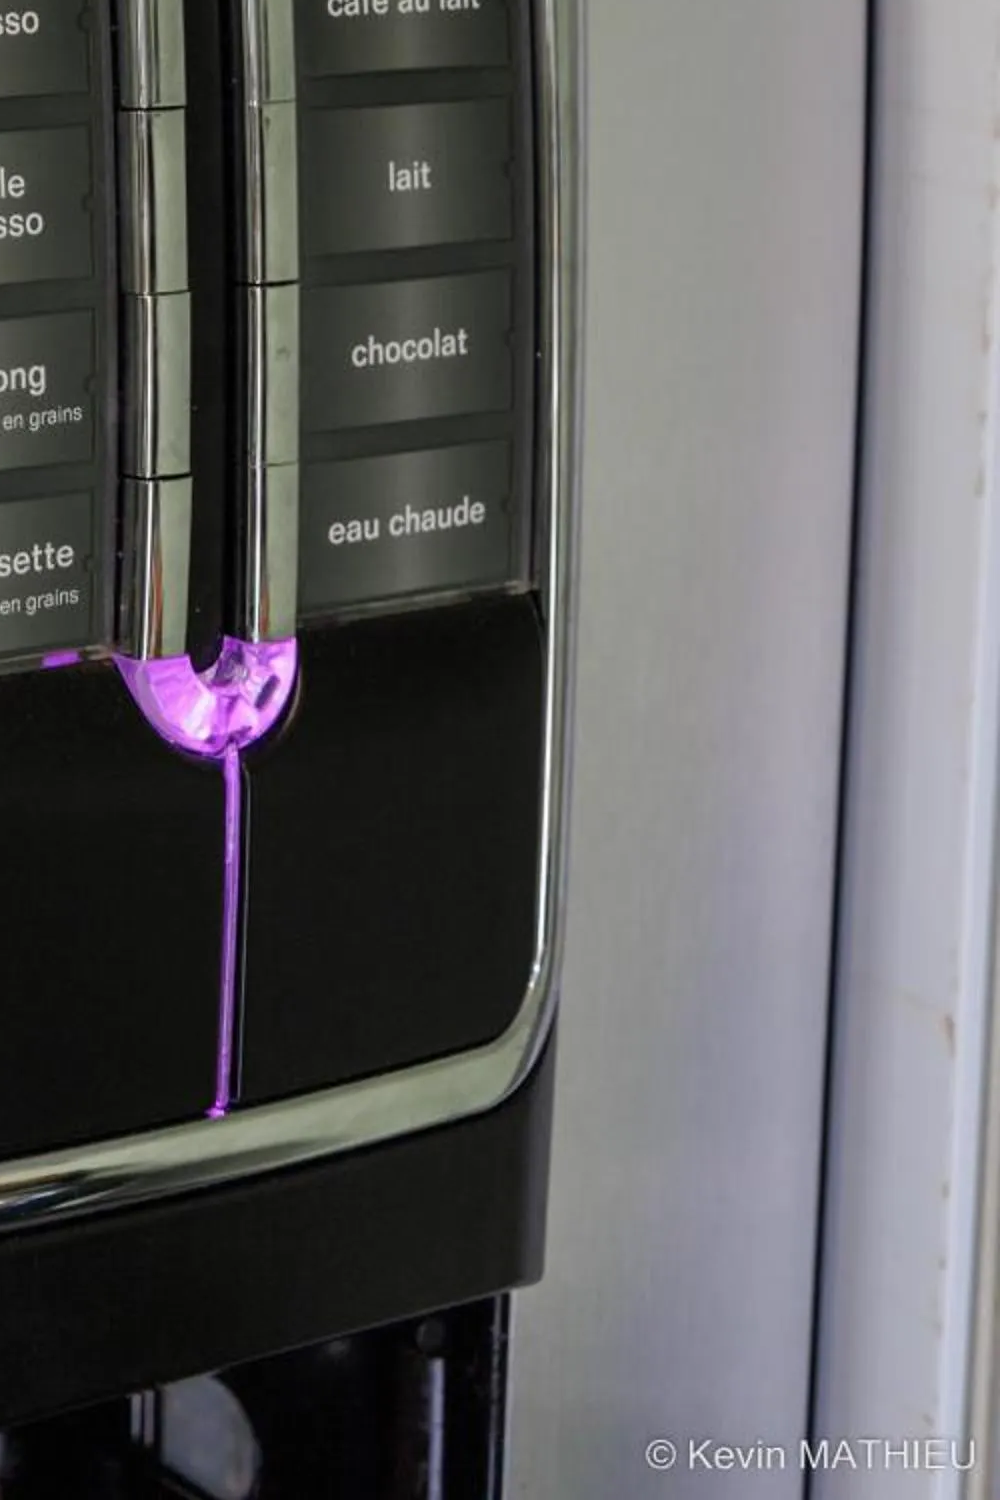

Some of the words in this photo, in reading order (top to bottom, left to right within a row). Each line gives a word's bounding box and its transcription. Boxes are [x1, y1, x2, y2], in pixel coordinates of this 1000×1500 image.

[387, 160, 432, 192] lait
[350, 328, 469, 369] chocolat
[3, 414, 24, 431] en
[28, 404, 83, 432] grains
[327, 518, 380, 545] eau
[388, 495, 486, 536] chaude
[0, 599, 21, 614] en
[26, 587, 80, 615] grains
